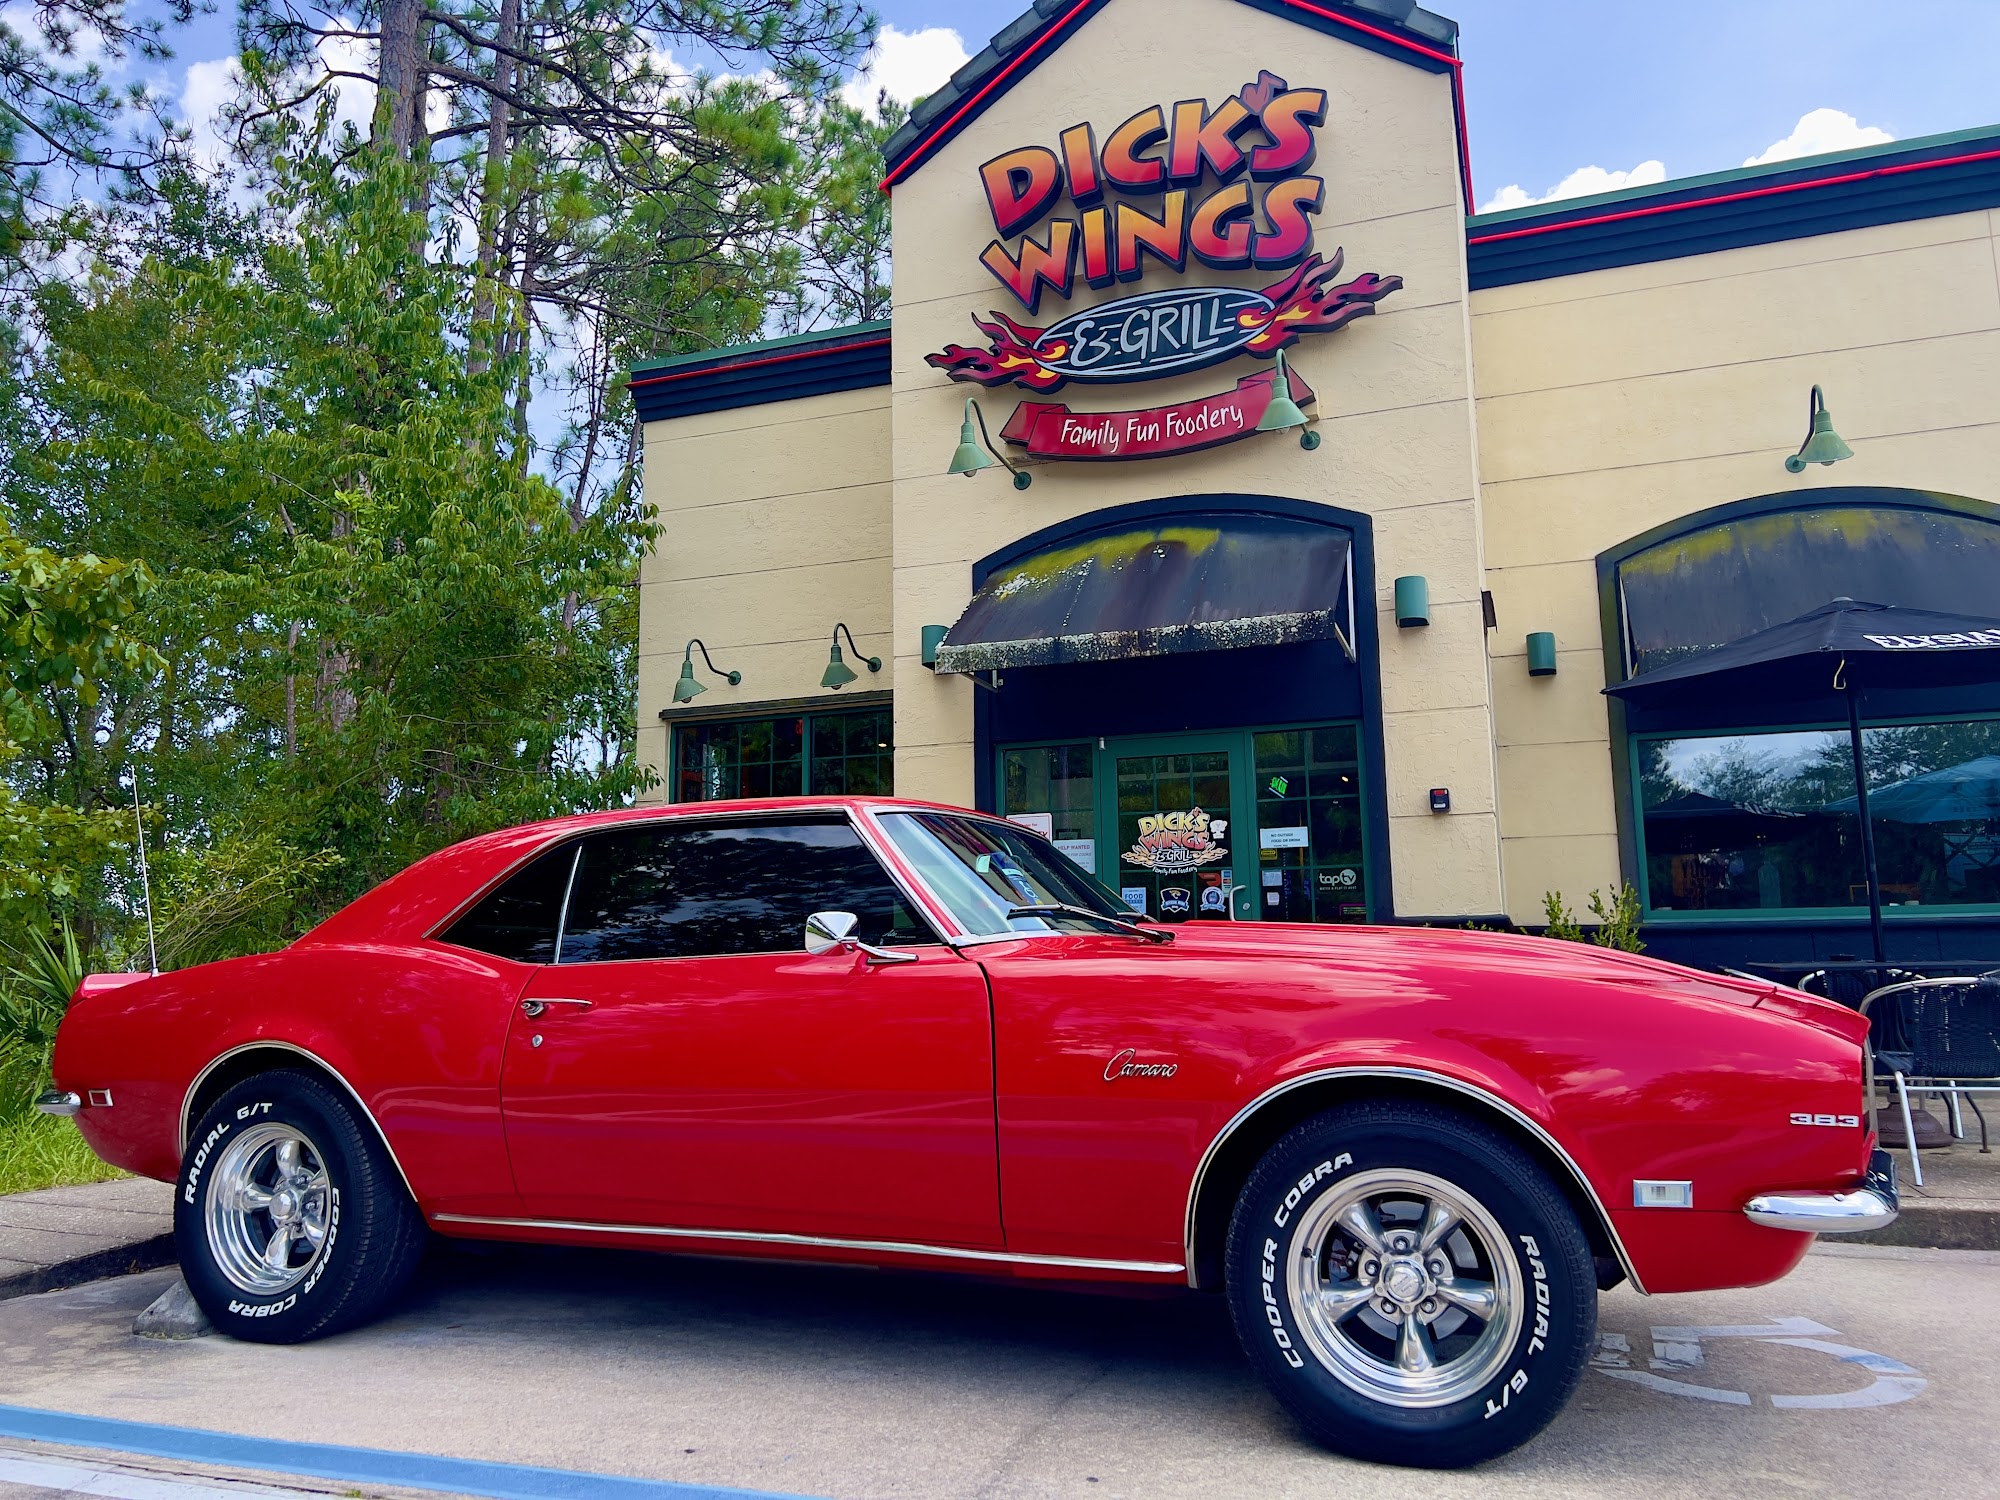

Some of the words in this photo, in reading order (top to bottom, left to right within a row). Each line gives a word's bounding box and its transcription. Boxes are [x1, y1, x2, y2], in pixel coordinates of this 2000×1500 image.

[979, 72, 1329, 240] DICK'S
[979, 176, 1325, 315] WINGS
[1120, 297, 1226, 360] GRILL
[1060, 417, 1120, 453] Family
[1125, 418, 1161, 442] Fun
[1165, 401, 1245, 439] Foodery
[1138, 807, 1210, 837] DICK'S
[1139, 831, 1209, 852] WINGS
[1166, 849, 1192, 862] GRILL
[1103, 1048, 1178, 1081] Camaro
[1789, 1112, 1859, 1127] 383
[184, 1121, 230, 1204] RADIAL
[236, 1102, 272, 1120] G/T
[1273, 1152, 1353, 1228] COBRA
[304, 1187, 340, 1295] COOPER
[228, 1293, 297, 1317] COBRA
[1261, 1237, 1304, 1369] COOPER
[1519, 1234, 1549, 1355] RADIAL
[1484, 1369, 1529, 1419] G/T
